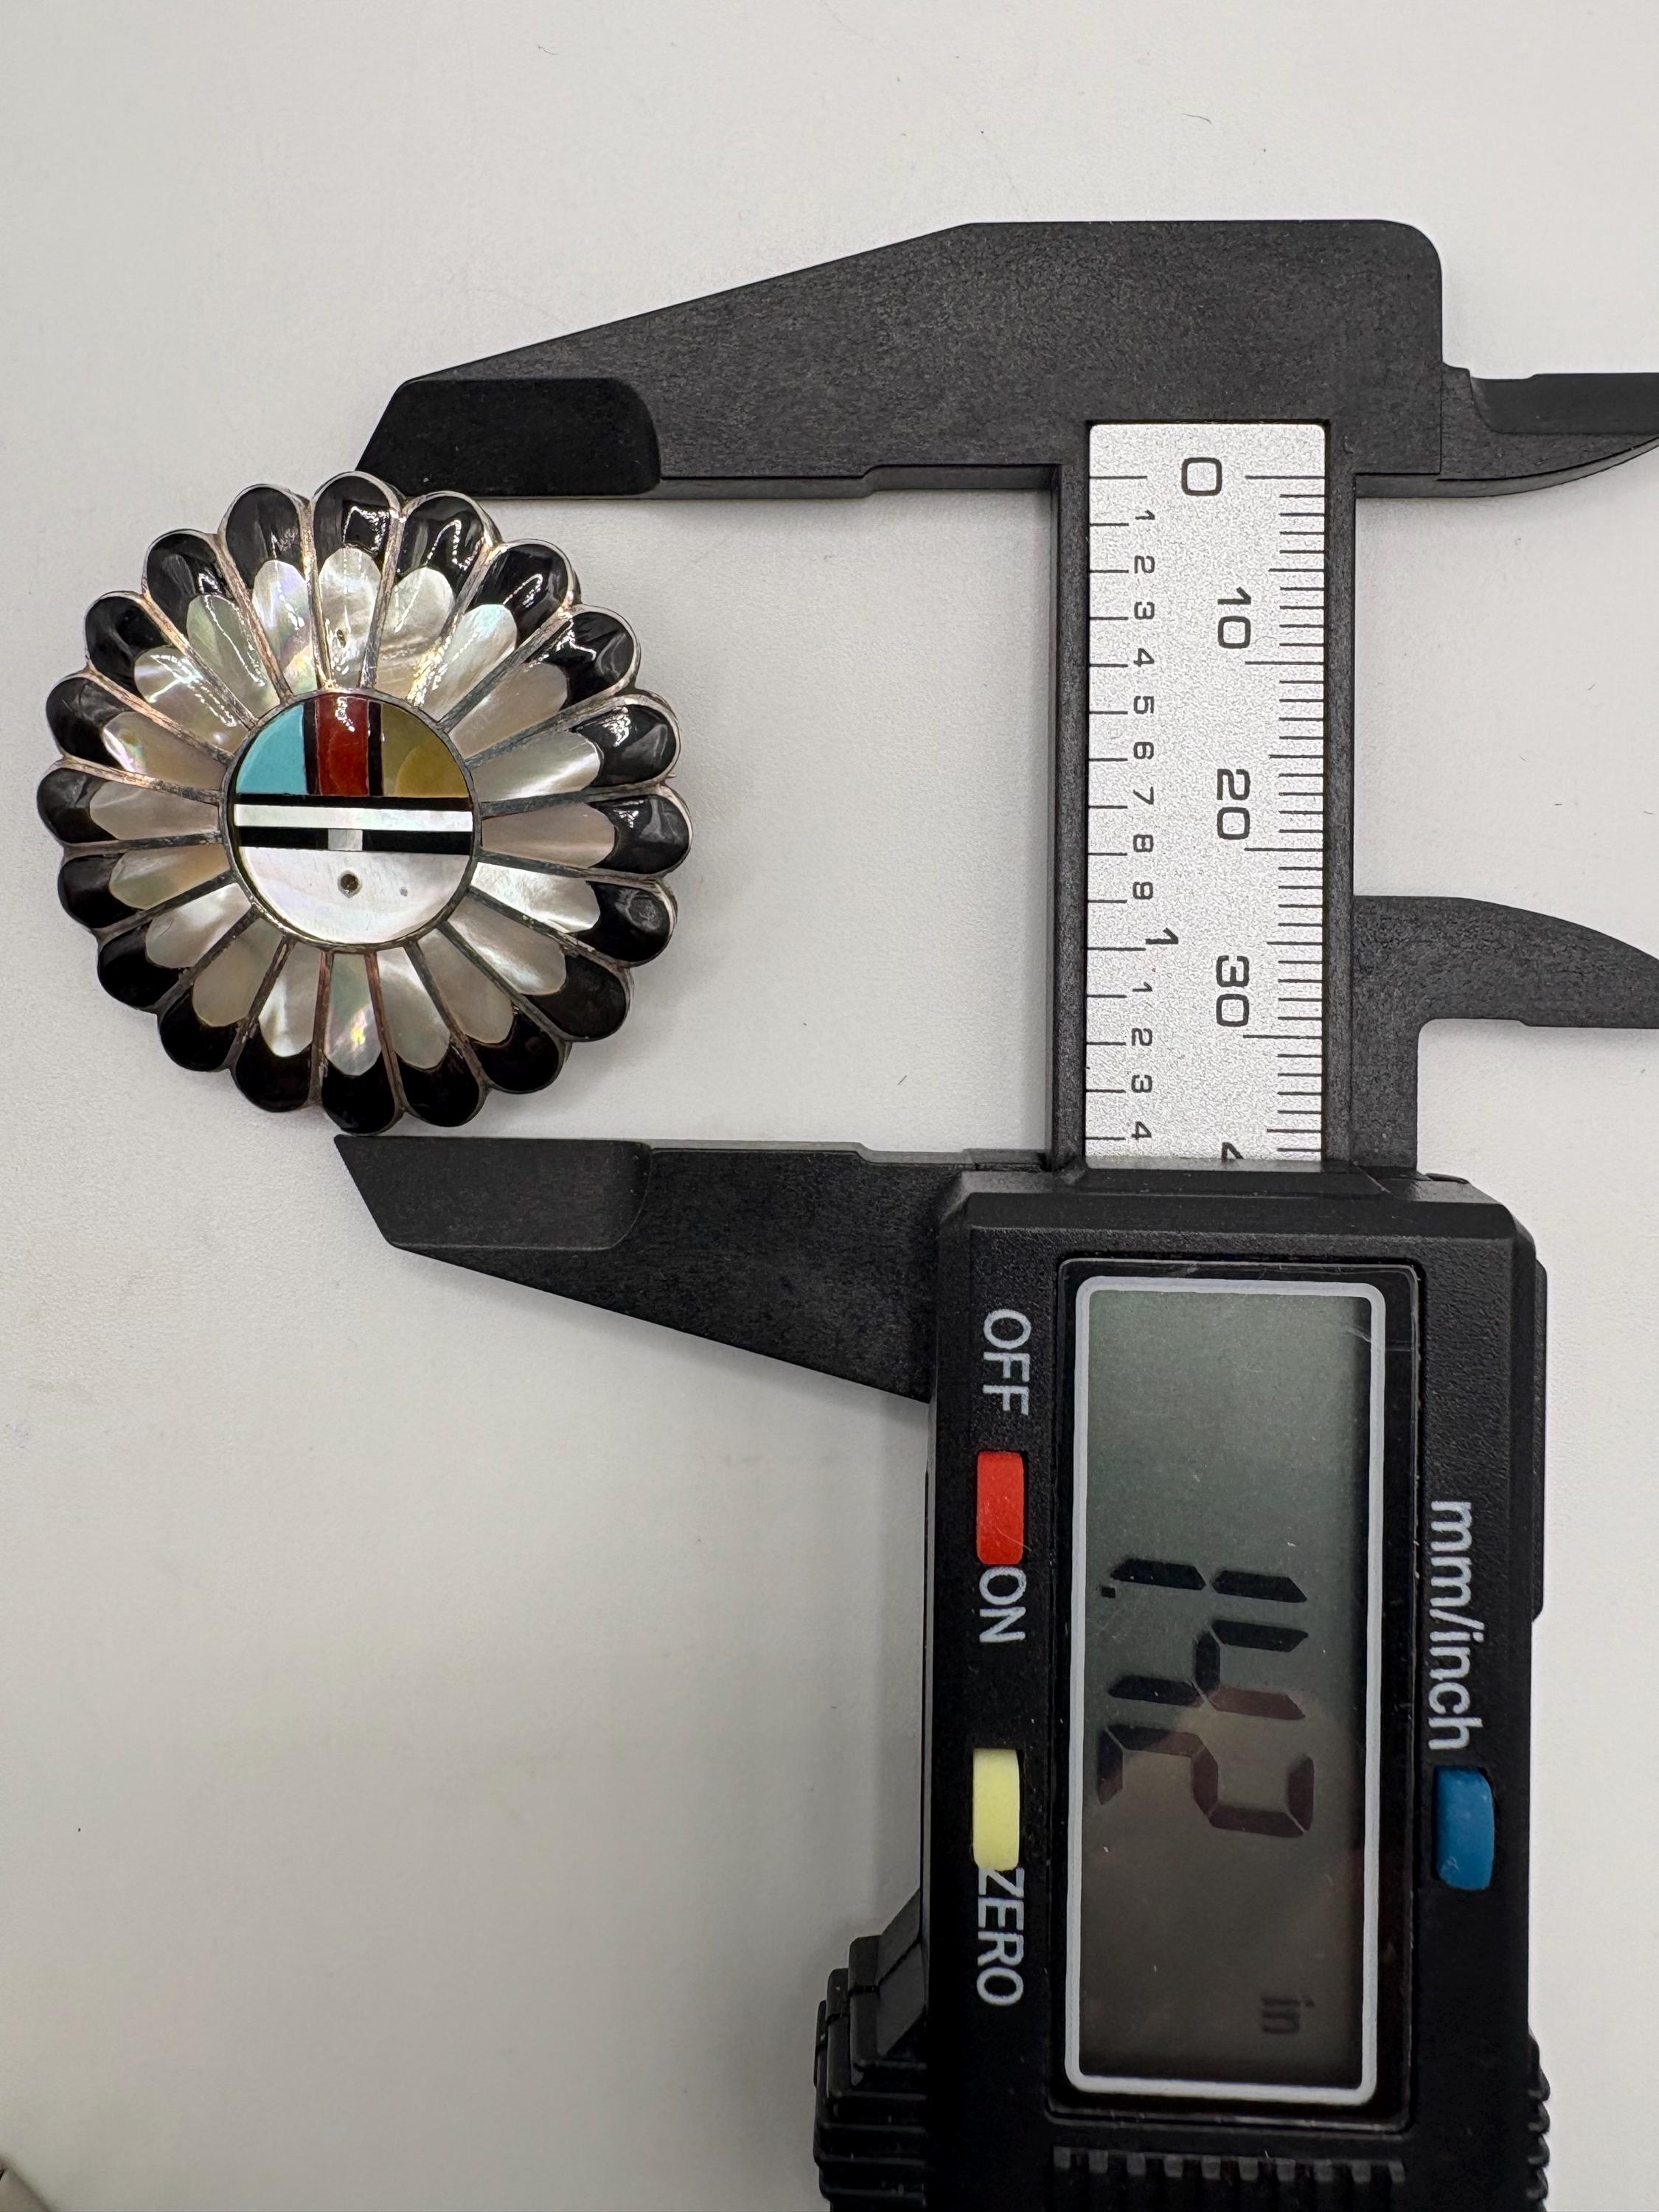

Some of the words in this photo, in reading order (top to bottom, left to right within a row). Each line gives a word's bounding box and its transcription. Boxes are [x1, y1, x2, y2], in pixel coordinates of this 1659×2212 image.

[1182, 457, 1222, 495] 0
[1135, 510, 1155, 520] 1
[1135, 556, 1155, 573] 2
[1135, 602, 1154, 619] 3
[1218, 588, 1251, 648] 10
[1134, 648, 1154, 667] 4
[1134, 696, 1154, 714] 5
[1133, 742, 1154, 759] 6
[1133, 787, 1154, 804] 7
[1217, 769, 1251, 840] 20
[1133, 834, 1153, 852] 8
[1133, 882, 1153, 900] 9
[1146, 928, 1178, 945] 1
[1133, 982, 1152, 992] 1
[1217, 956, 1249, 1026] 30
[1132, 1029, 1152, 1046] 2
[1132, 1075, 1152, 1093] 3
[1132, 1121, 1151, 1140] 4
[984, 1310, 1031, 1415] OFF
[980, 1568, 1026, 1641] ON
[1429, 1501, 1484, 1749] mm/inch
[1097, 1557, 1314, 1837] 1.42
[977, 1868, 1026, 2005] ZERO
[1260, 1995, 1315, 2034] in
